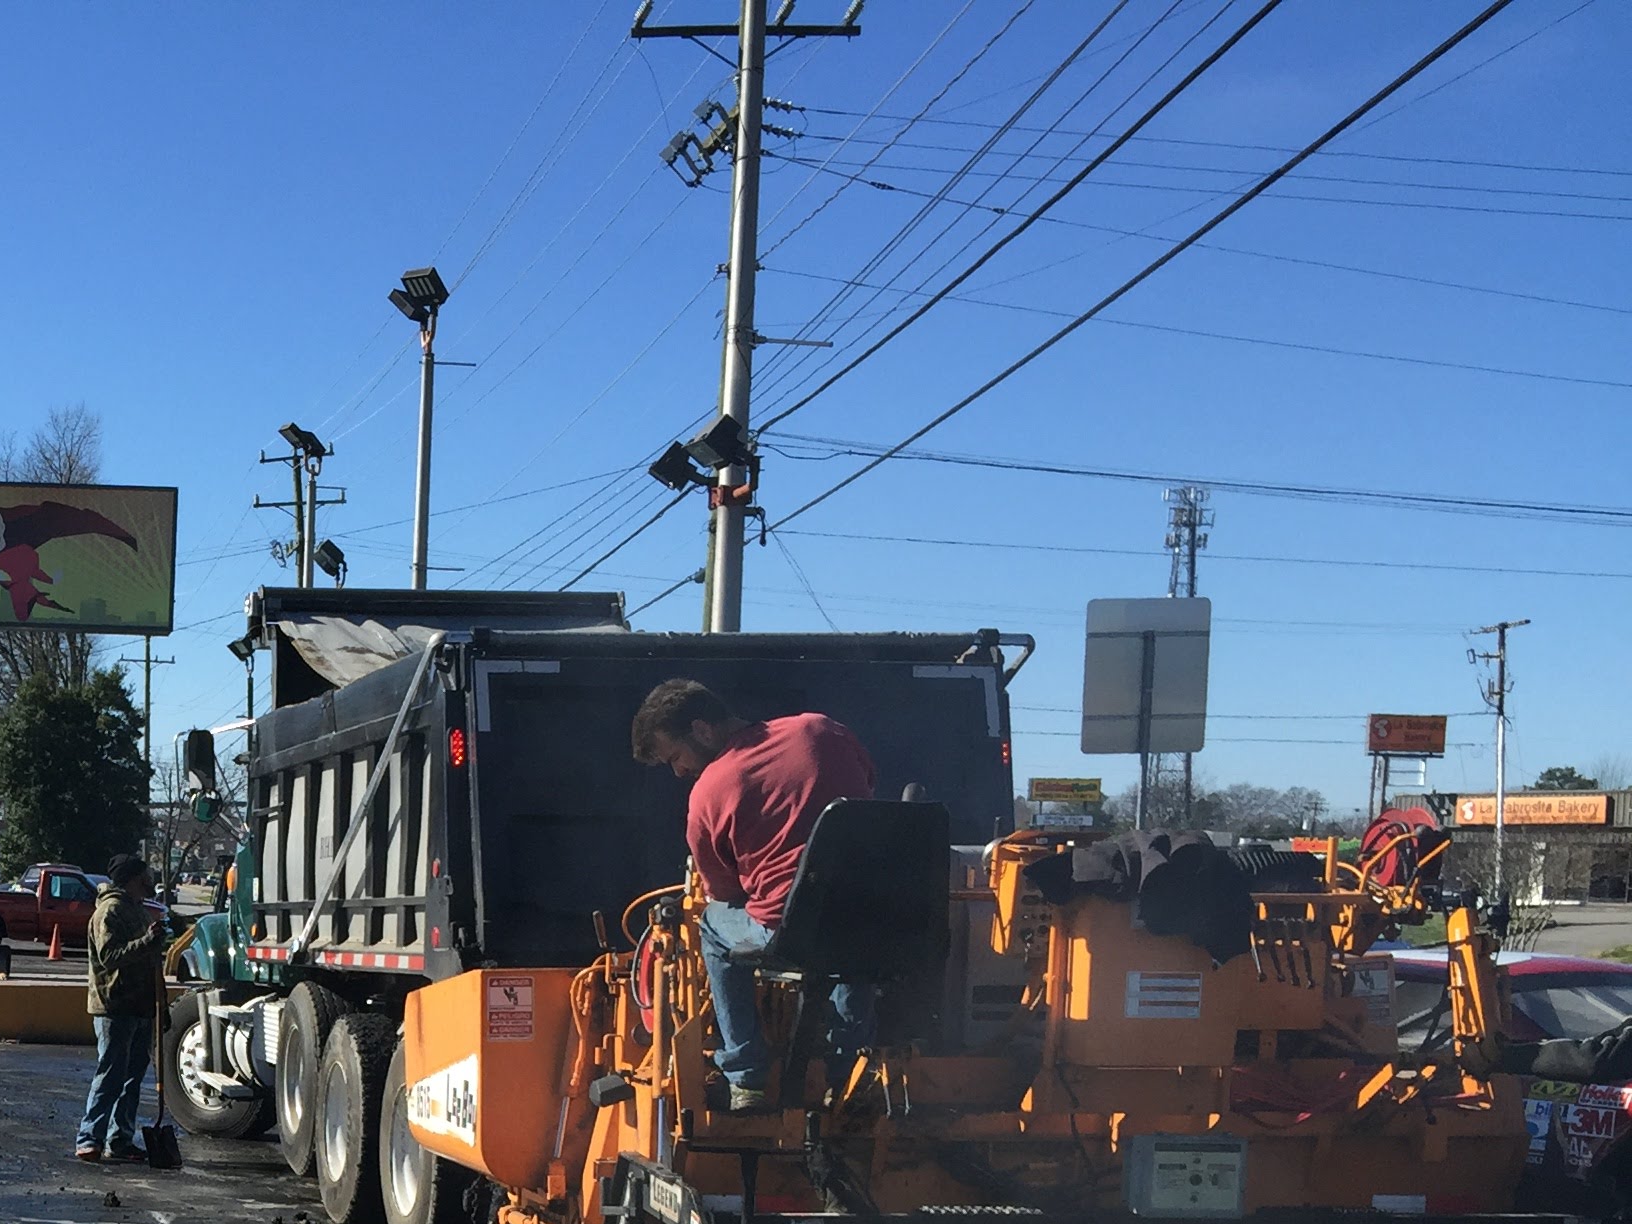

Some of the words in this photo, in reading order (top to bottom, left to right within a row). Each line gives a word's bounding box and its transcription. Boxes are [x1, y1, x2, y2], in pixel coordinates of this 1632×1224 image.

[1479, 801, 1493, 813] La
[1503, 800, 1552, 813] abrosita
[1558, 799, 1600, 816] Bakery
[1571, 1108, 1612, 1135] 3M
[653, 1176, 678, 1213] LEGEND
